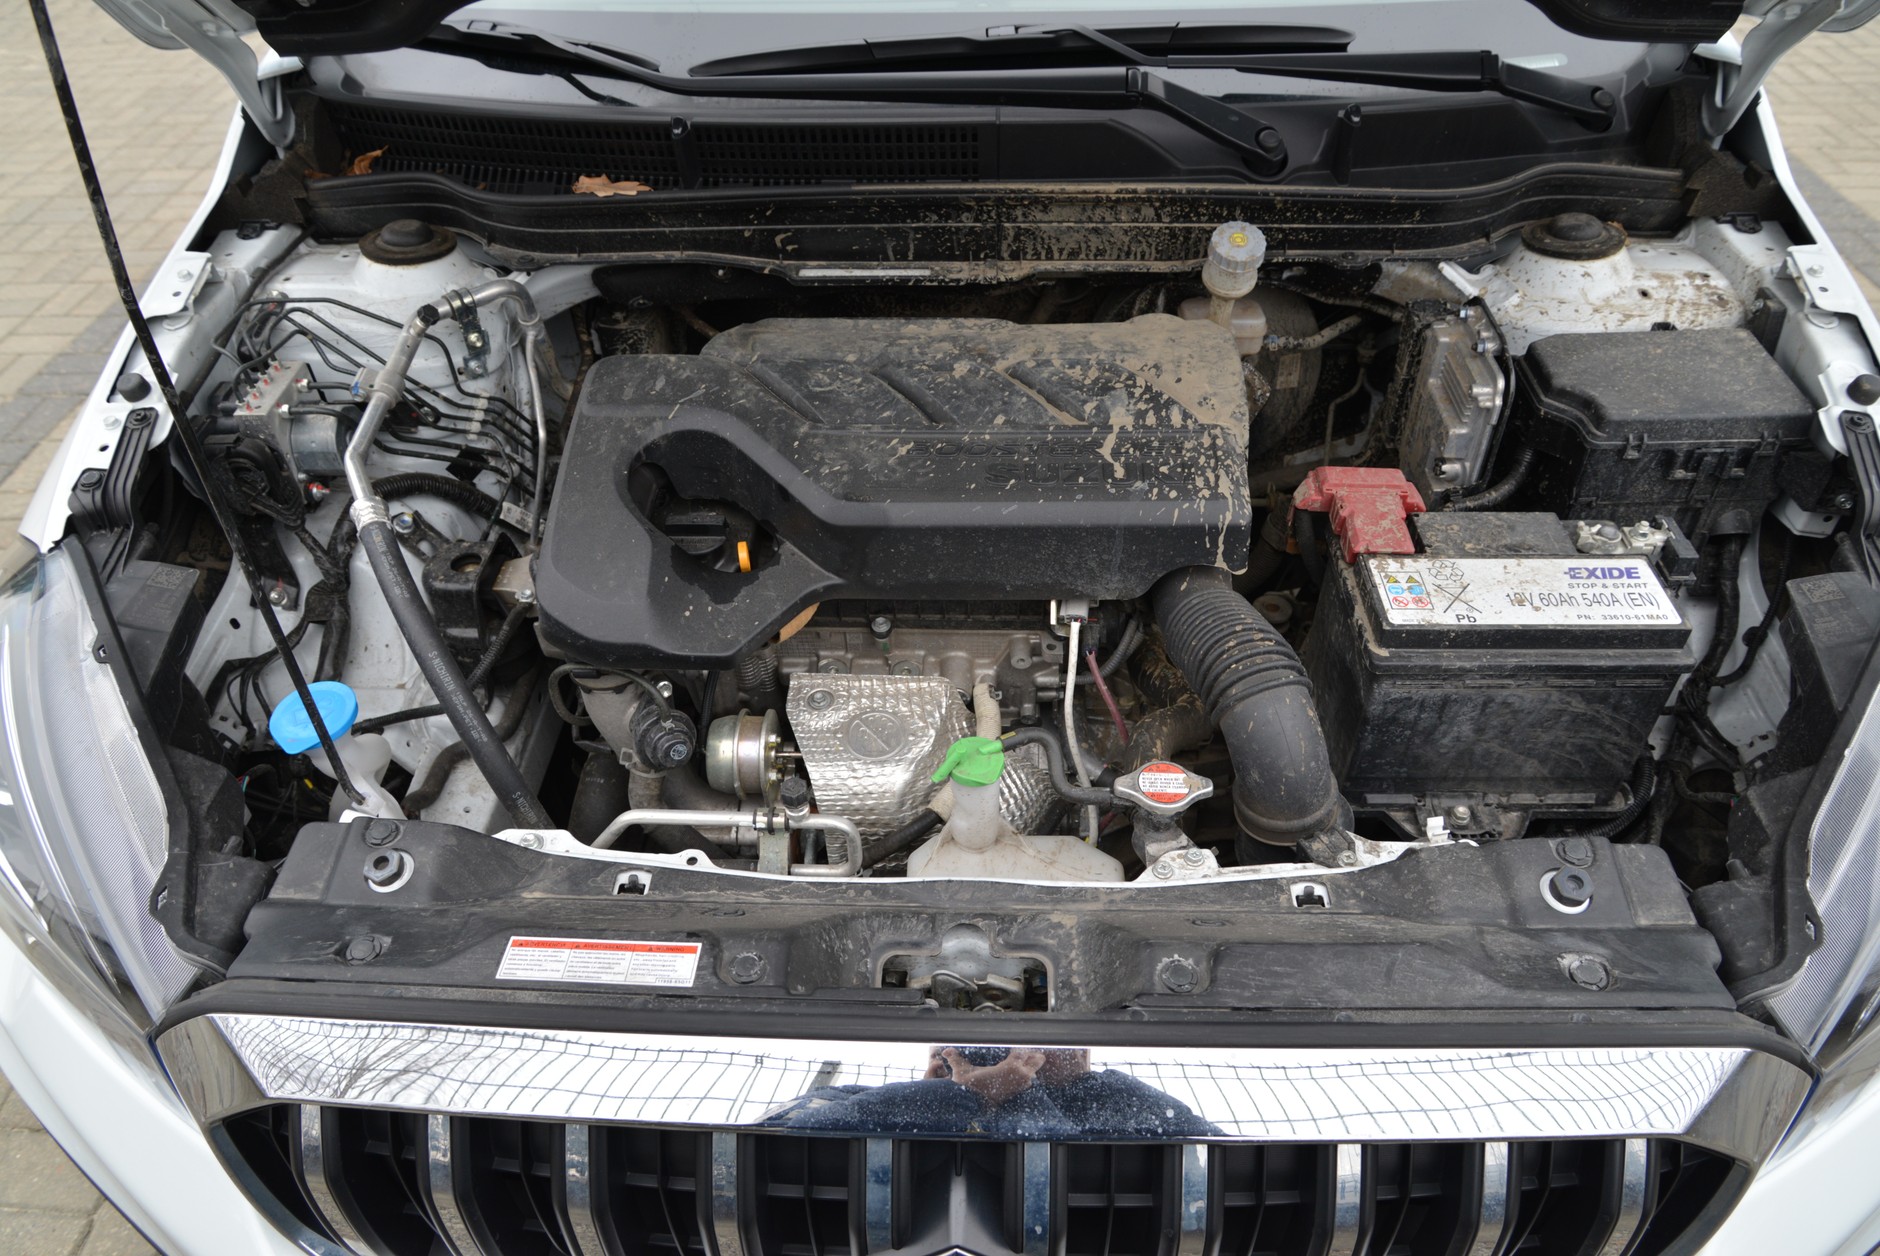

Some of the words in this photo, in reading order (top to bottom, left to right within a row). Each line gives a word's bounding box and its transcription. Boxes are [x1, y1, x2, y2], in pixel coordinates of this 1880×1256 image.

[984, 463, 1196, 487] SUZUKI
[1564, 567, 1641, 579] EXIDE
[1505, 592, 1534, 606] 12V
[1539, 592, 1580, 607] 60Ah
[1584, 592, 1623, 607] 540A
[1623, 592, 1660, 610] (EN)
[1455, 613, 1477, 623] Pb
